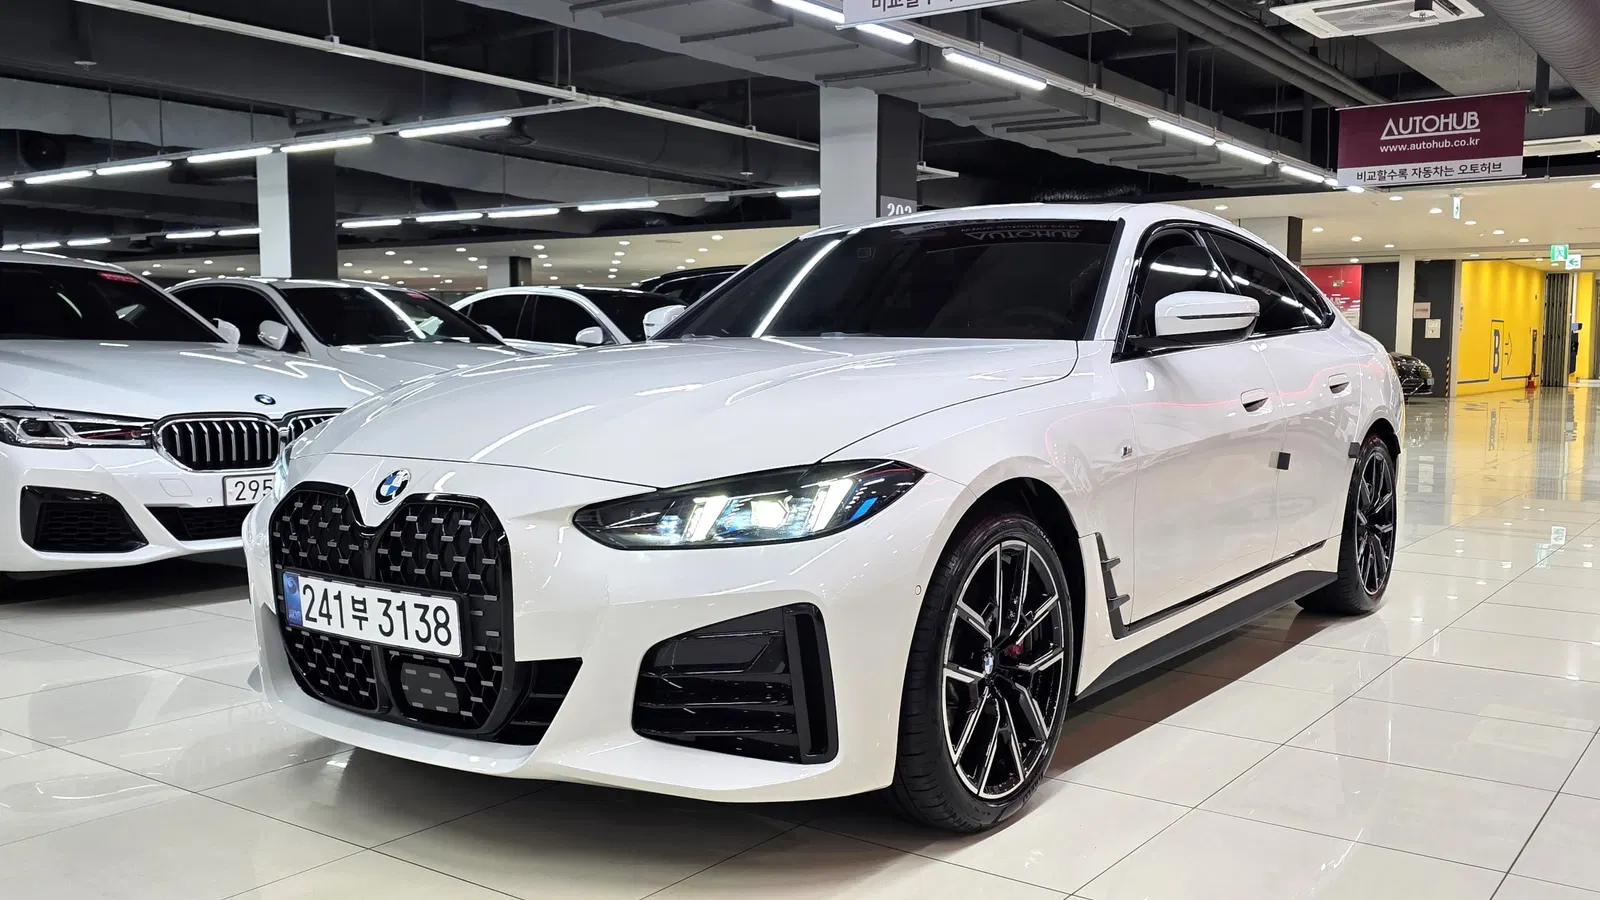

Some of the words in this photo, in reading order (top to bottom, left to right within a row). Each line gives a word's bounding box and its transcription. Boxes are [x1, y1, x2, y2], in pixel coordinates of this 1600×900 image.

[1380, 111, 1481, 140] AUTOHUB
[1380, 137, 1480, 152] www.autohub.co.kr
[1356, 169, 1408, 182] 비교할수록
[1411, 165, 1455, 179] 자동차는
[1458, 162, 1503, 175] 오토허브
[234, 479, 273, 501] 295
[302, 583, 369, 631] 241부
[377, 597, 452, 647] 3138
